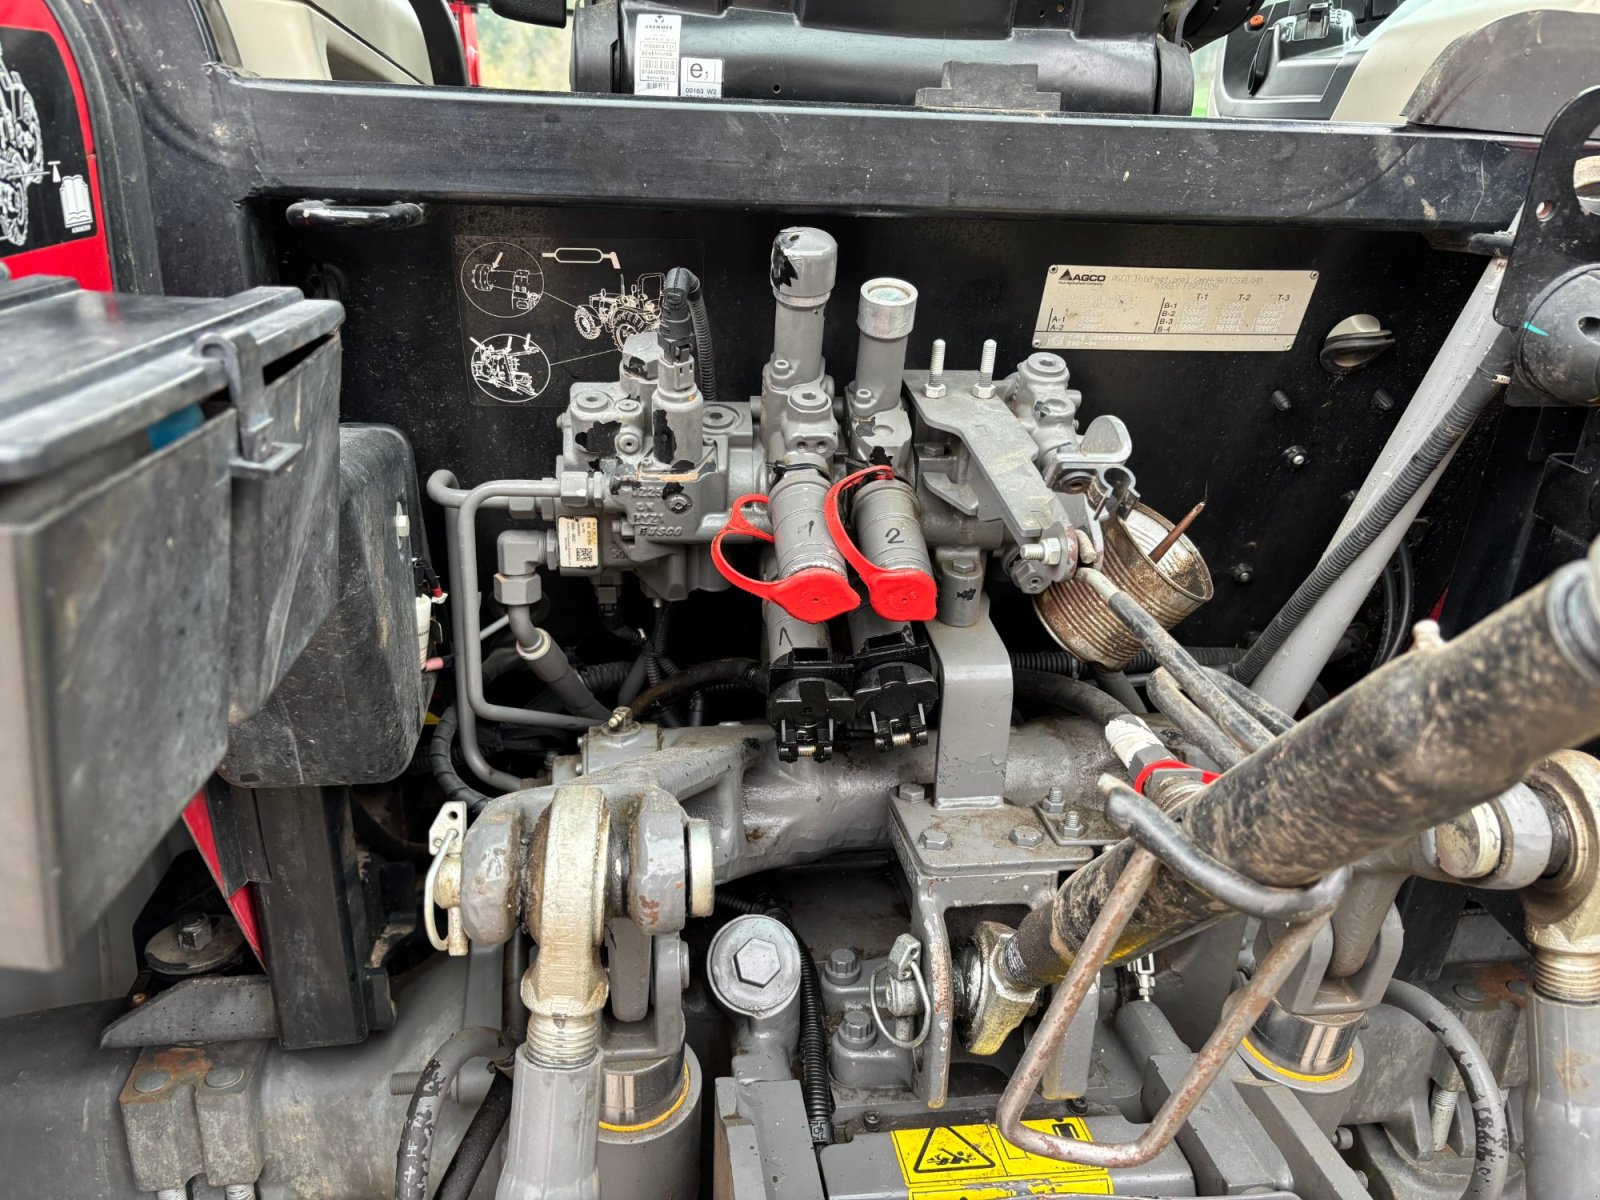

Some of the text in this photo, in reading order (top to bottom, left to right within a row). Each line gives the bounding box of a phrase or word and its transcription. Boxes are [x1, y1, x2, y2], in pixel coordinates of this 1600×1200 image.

[1073, 273, 1107, 282] AGCO
[1196, 293, 1291, 302] T-1 T-2 T-3
[797, 520, 815, 537] 1
[885, 527, 904, 544] 2
